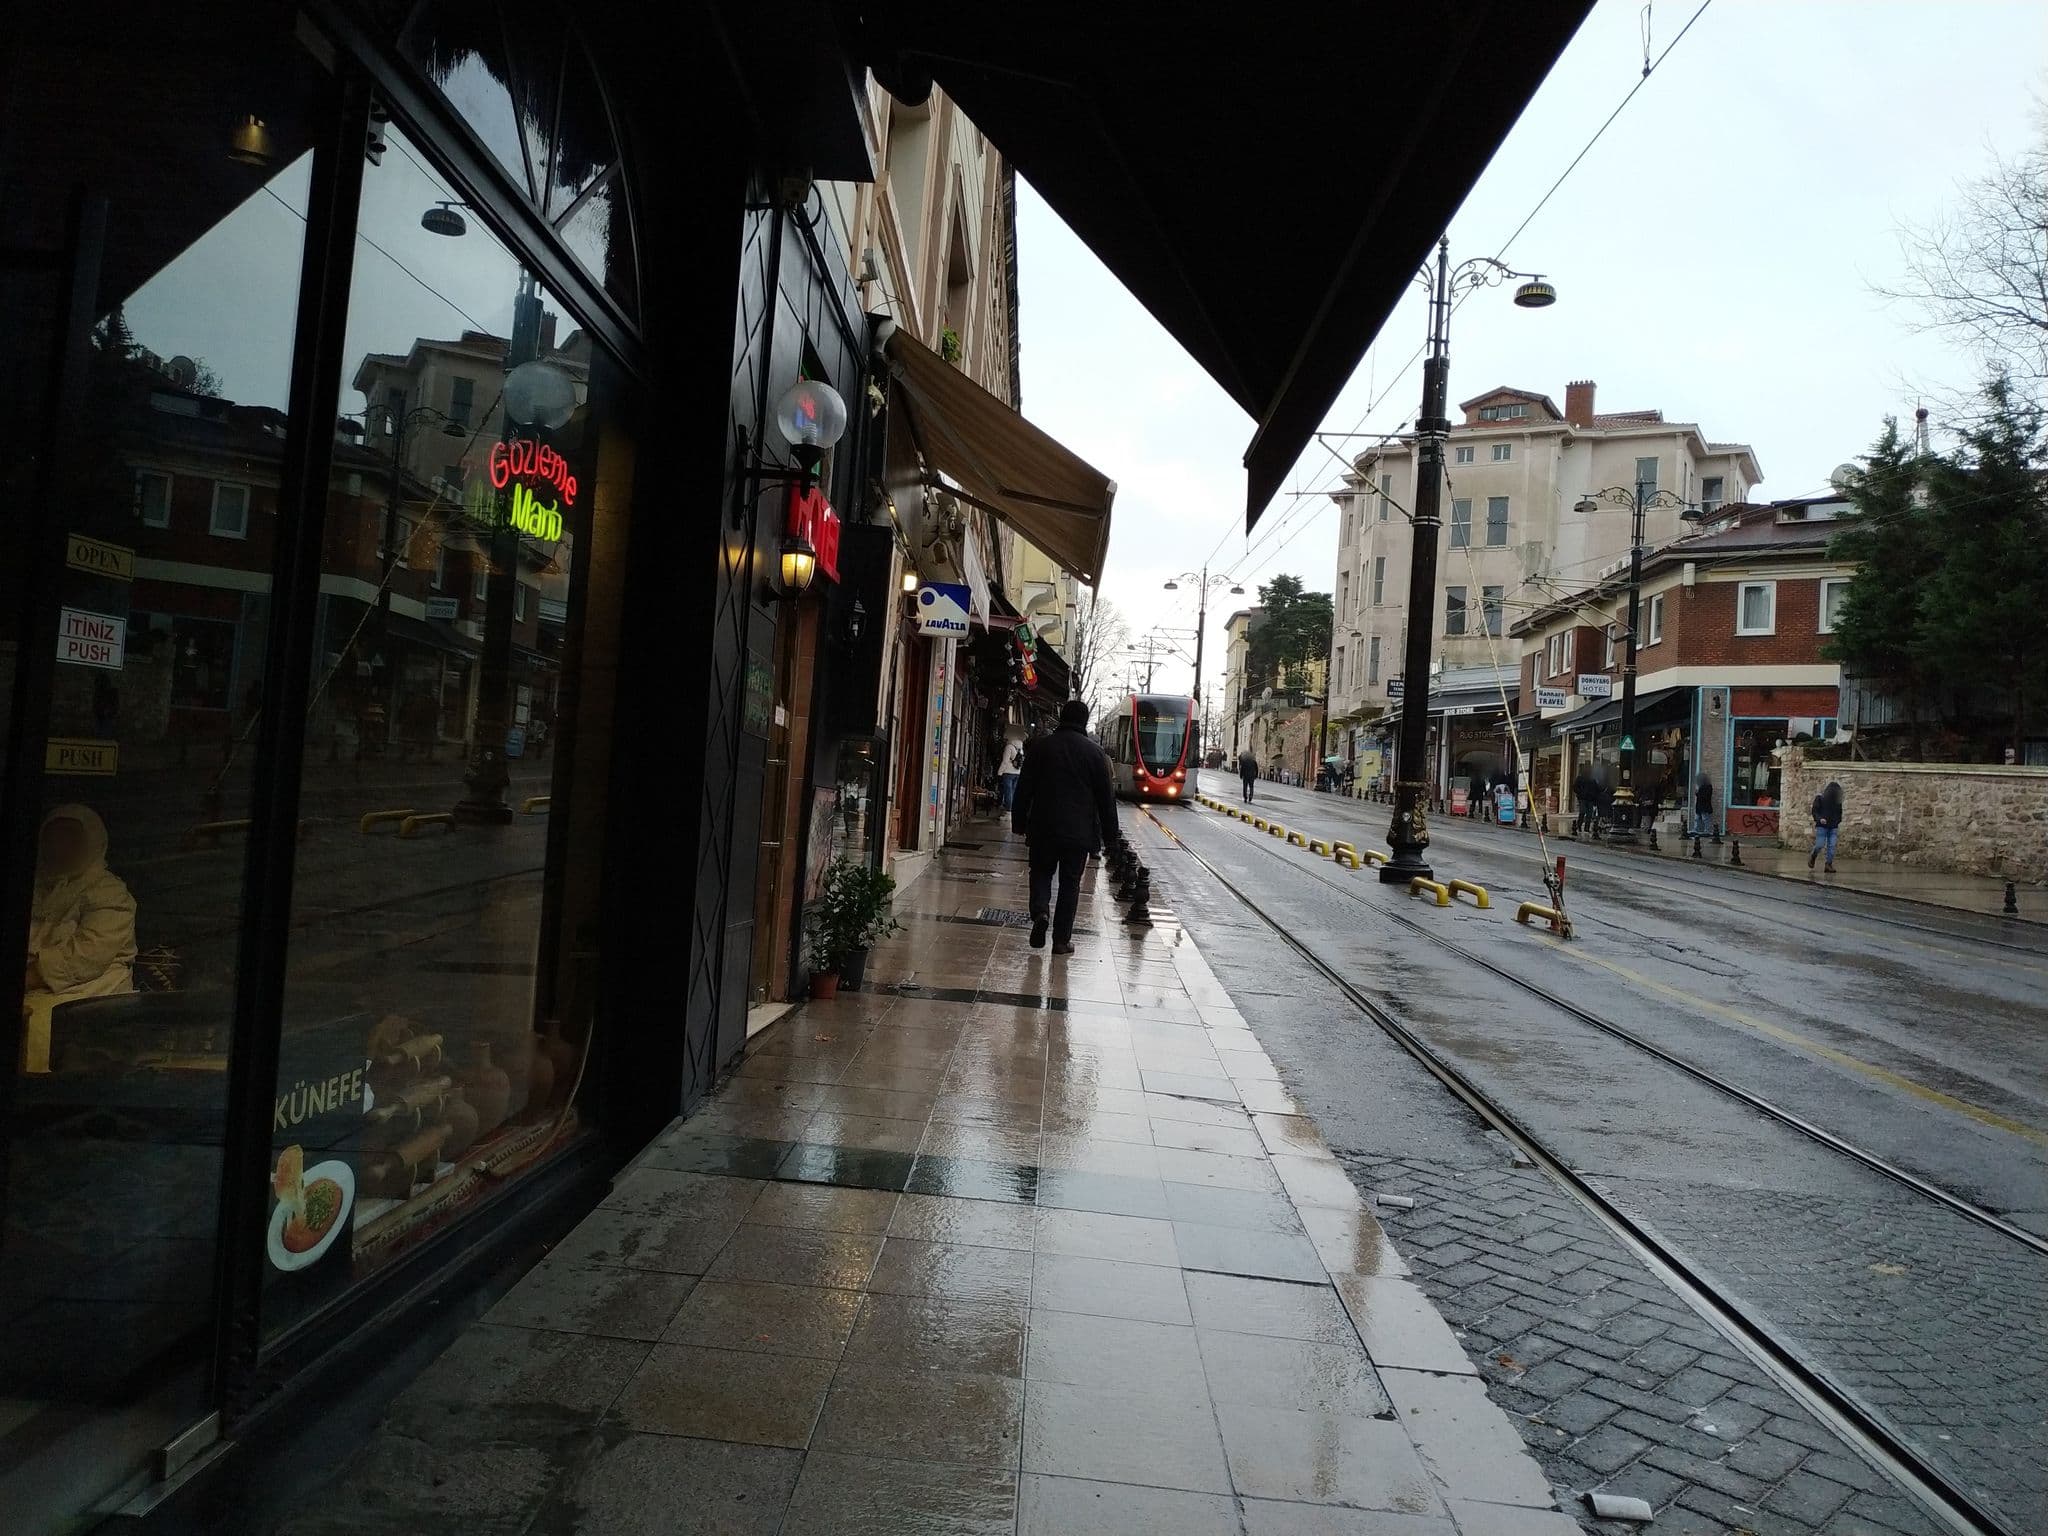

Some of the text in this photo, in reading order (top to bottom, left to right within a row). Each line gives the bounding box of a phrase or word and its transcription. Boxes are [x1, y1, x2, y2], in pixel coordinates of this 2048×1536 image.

[75, 544, 122, 571] OPEN
[66, 614, 115, 641] İTİNİZ
[925, 618, 967, 631] LAVAZZA
[67, 640, 112, 663] PUSH
[1582, 685, 1608, 693] HOTEL
[59, 747, 103, 769] PUSH
[272, 1067, 364, 1133] KÜNEFE
